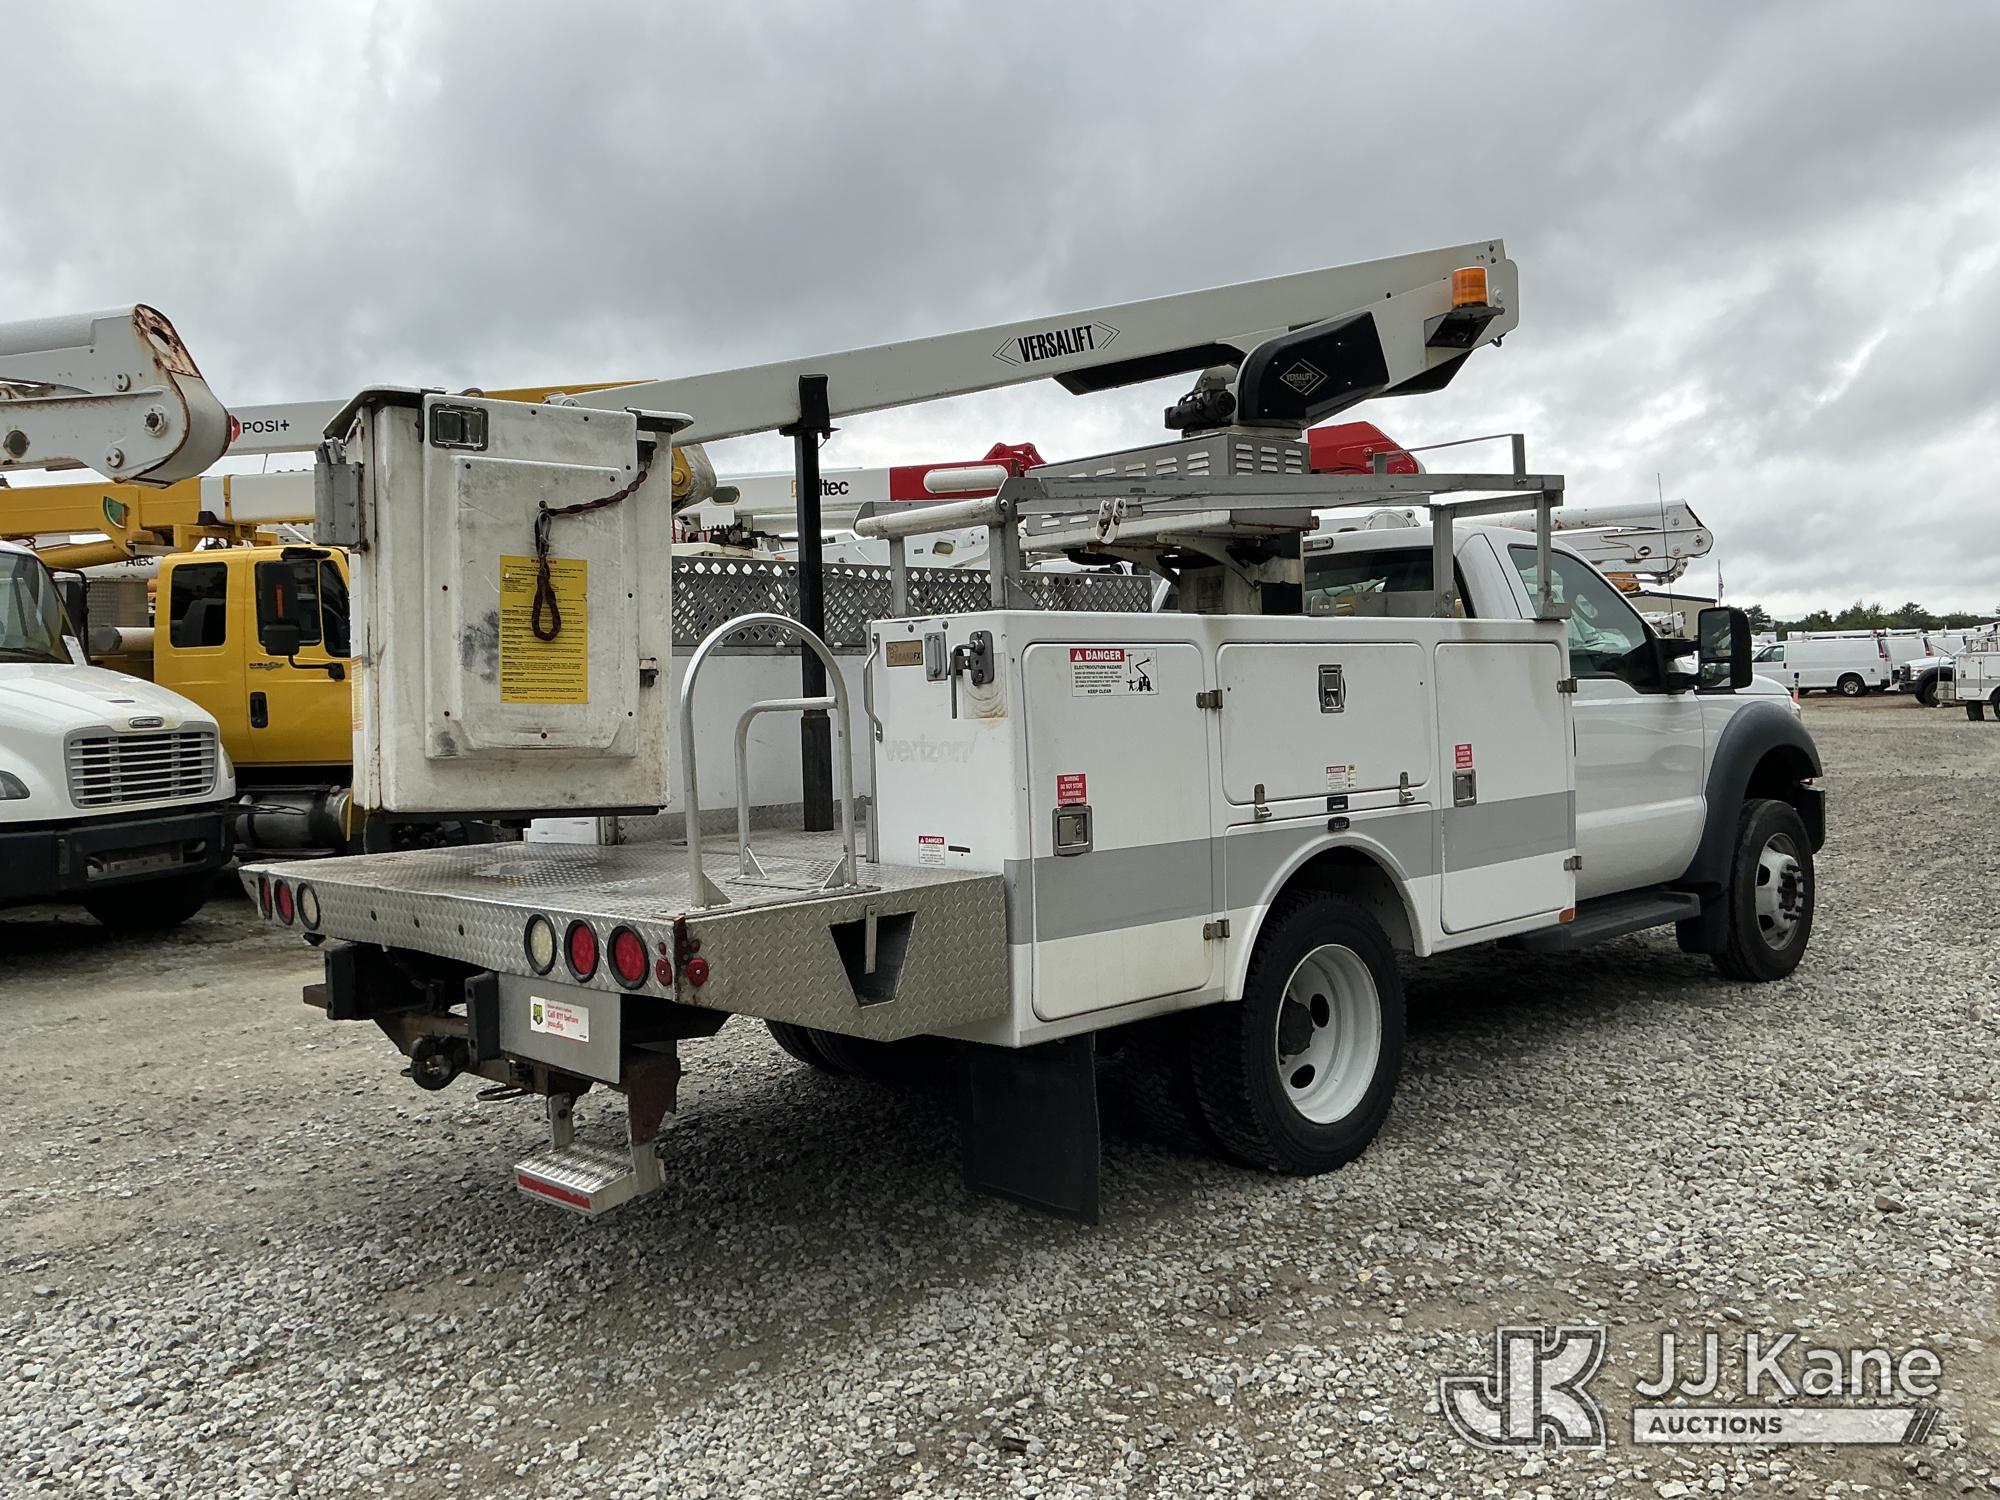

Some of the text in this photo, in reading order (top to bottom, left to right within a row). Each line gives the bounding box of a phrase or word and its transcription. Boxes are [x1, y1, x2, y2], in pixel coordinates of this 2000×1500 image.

[1017, 325, 1095, 362] VERSALIFT
[242, 419, 290, 434] POSI+
[818, 478, 849, 496] ltec
[1085, 650, 1121, 660] DANGER
